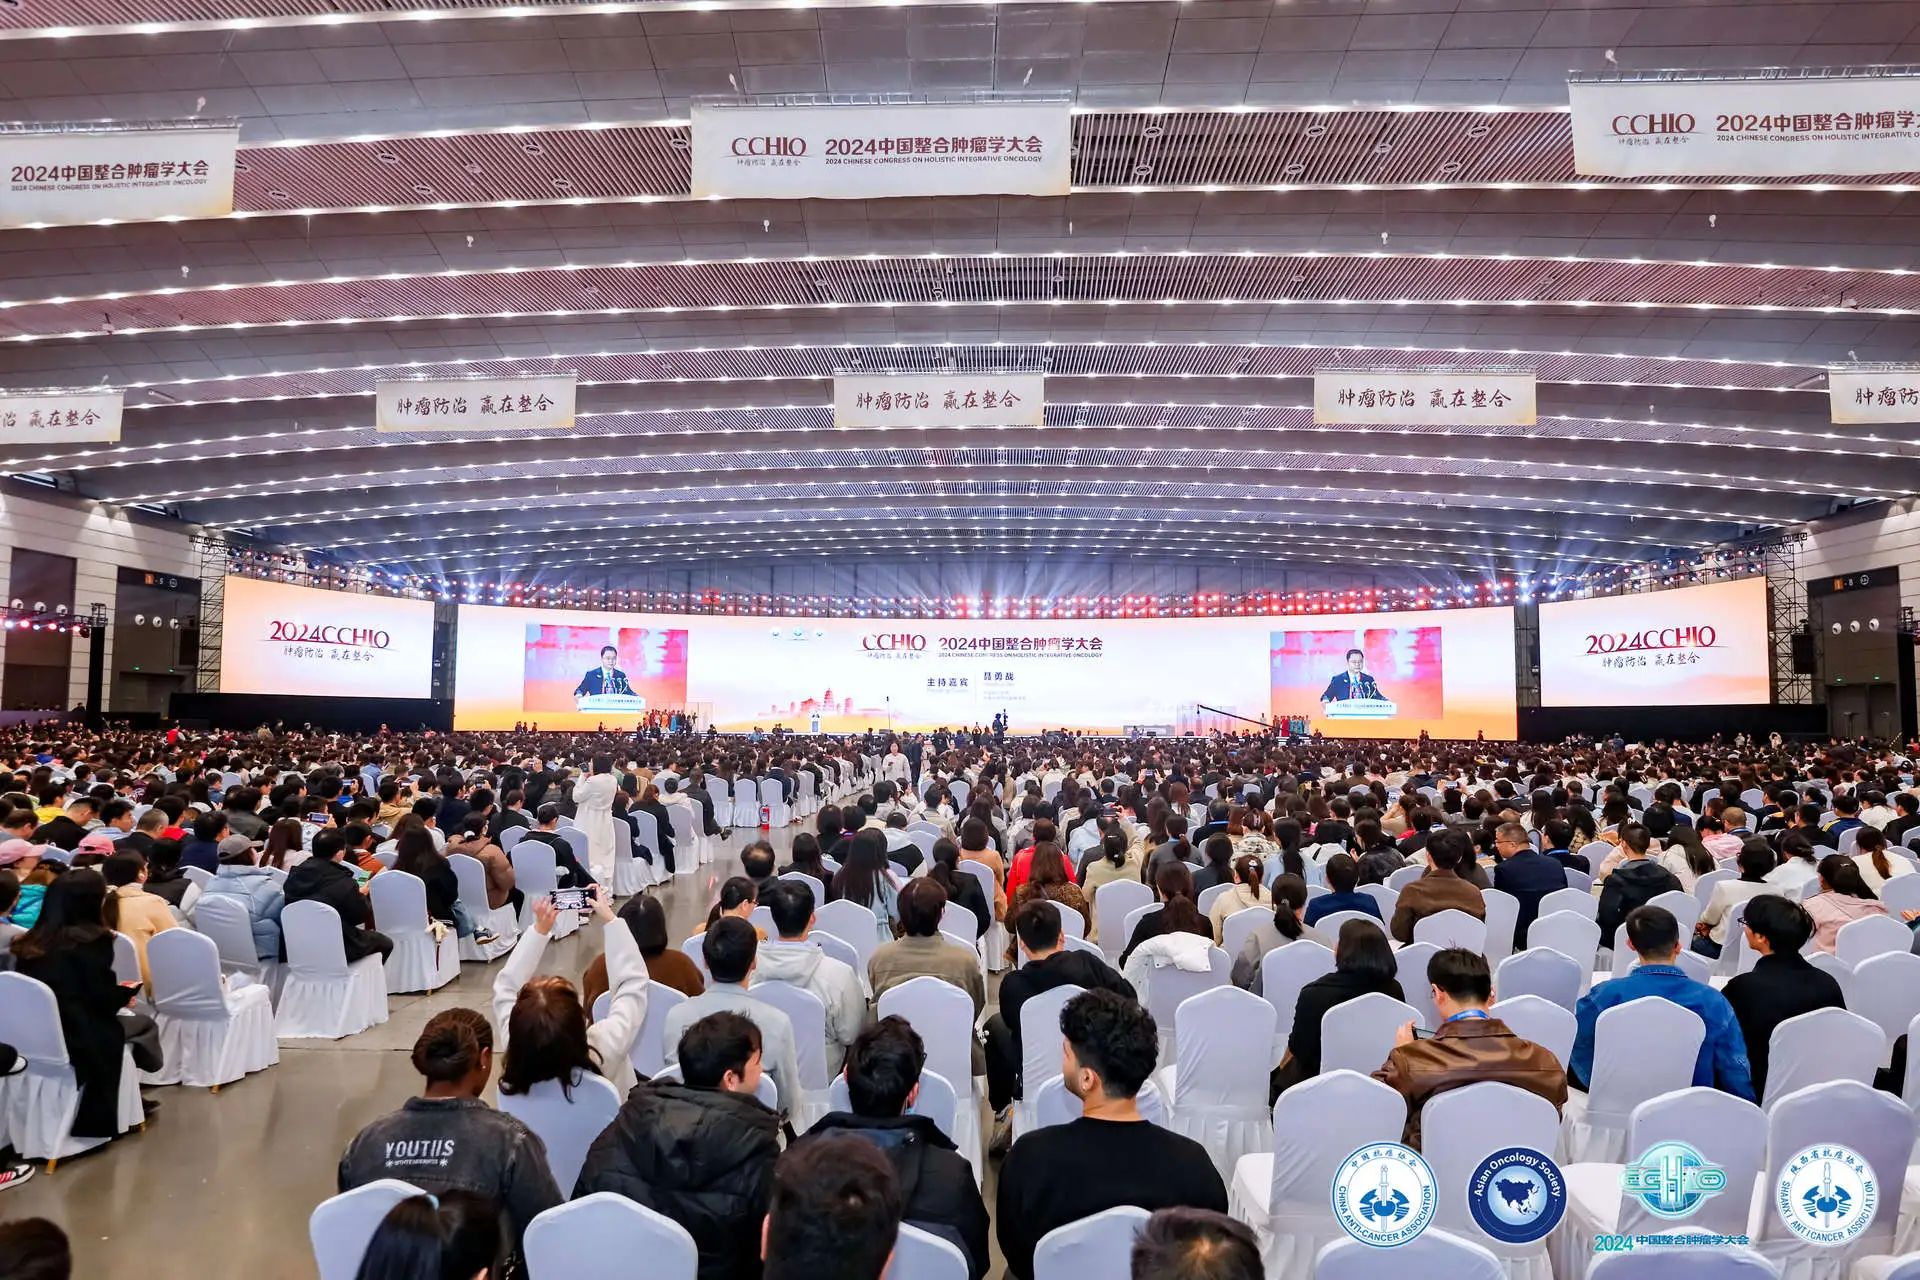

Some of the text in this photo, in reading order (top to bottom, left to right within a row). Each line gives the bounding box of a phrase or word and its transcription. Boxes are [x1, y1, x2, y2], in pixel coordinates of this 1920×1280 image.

[1612, 113, 1696, 135] CCHIO
[1716, 110, 1920, 132] 2024中国整合肿瘤学
[732, 137, 807, 156] CCHIO
[825, 135, 1043, 156] 2024中国整合肿瘤学大会
[1861, 131, 1912, 140] INTEGRATIVE
[11, 159, 209, 182] 2024中国整合肿瘤学大会
[396, 393, 554, 416] 肿瘤防治 赢在整合
[856, 389, 1022, 411] 肿瘤防治 赢在整合
[1337, 388, 1512, 409] 肿瘤防治 赢在整合
[270, 620, 390, 649] 2024CCHIO
[862, 633, 927, 651] CCHIO
[938, 637, 1103, 651] 2024中国整合肿瘤学大会
[1585, 625, 1716, 655] 2024CCHIO
